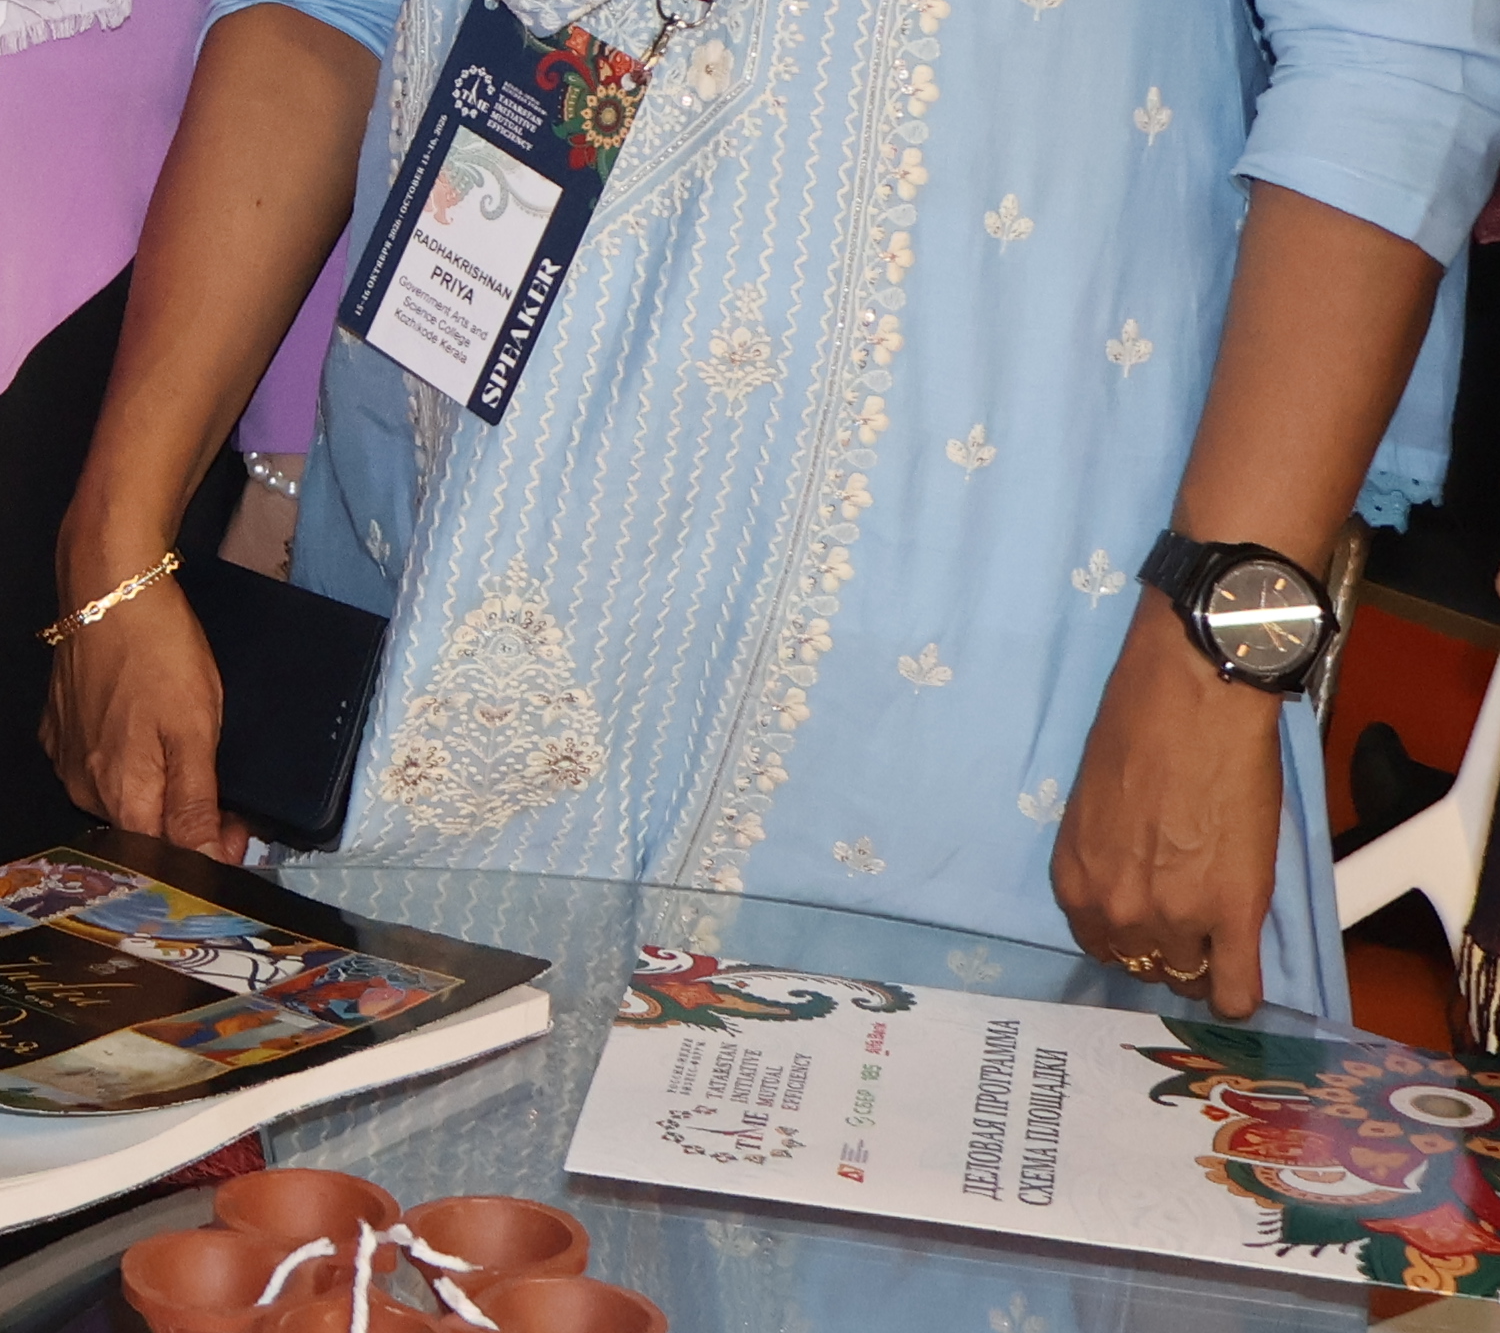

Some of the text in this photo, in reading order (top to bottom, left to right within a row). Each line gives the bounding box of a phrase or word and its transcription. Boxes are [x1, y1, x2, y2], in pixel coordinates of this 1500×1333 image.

[458, 87, 491, 114] TIME
[488, 109, 525, 136] MUTUAL
[492, 101, 538, 133] INITIATIVE
[496, 92, 544, 126] TATARSTAN
[485, 118, 533, 152] EFFICIENCY
[412, 228, 513, 301] RADHAKRISHNAN
[430, 266, 475, 305] PRIYA
[397, 273, 489, 341] Government Arts and
[401, 294, 472, 350] Science College
[437, 337, 468, 365] Kerala
[482, 256, 563, 409] SPEAKER
[706, 1041, 739, 1100] TATARSTAN
[730, 1048, 763, 1104] INITIATIVE
[756, 1066, 783, 1108] MUTUAL
[781, 1053, 812, 1111] EFFICIENCY
[735, 1111, 769, 1151] TIME
[963, 1020, 1020, 1201] ДЕЛОВАЯ ПРОГРАММА
[1018, 1047, 1071, 1206] СХЕМА ПЛОЩАДКИ
